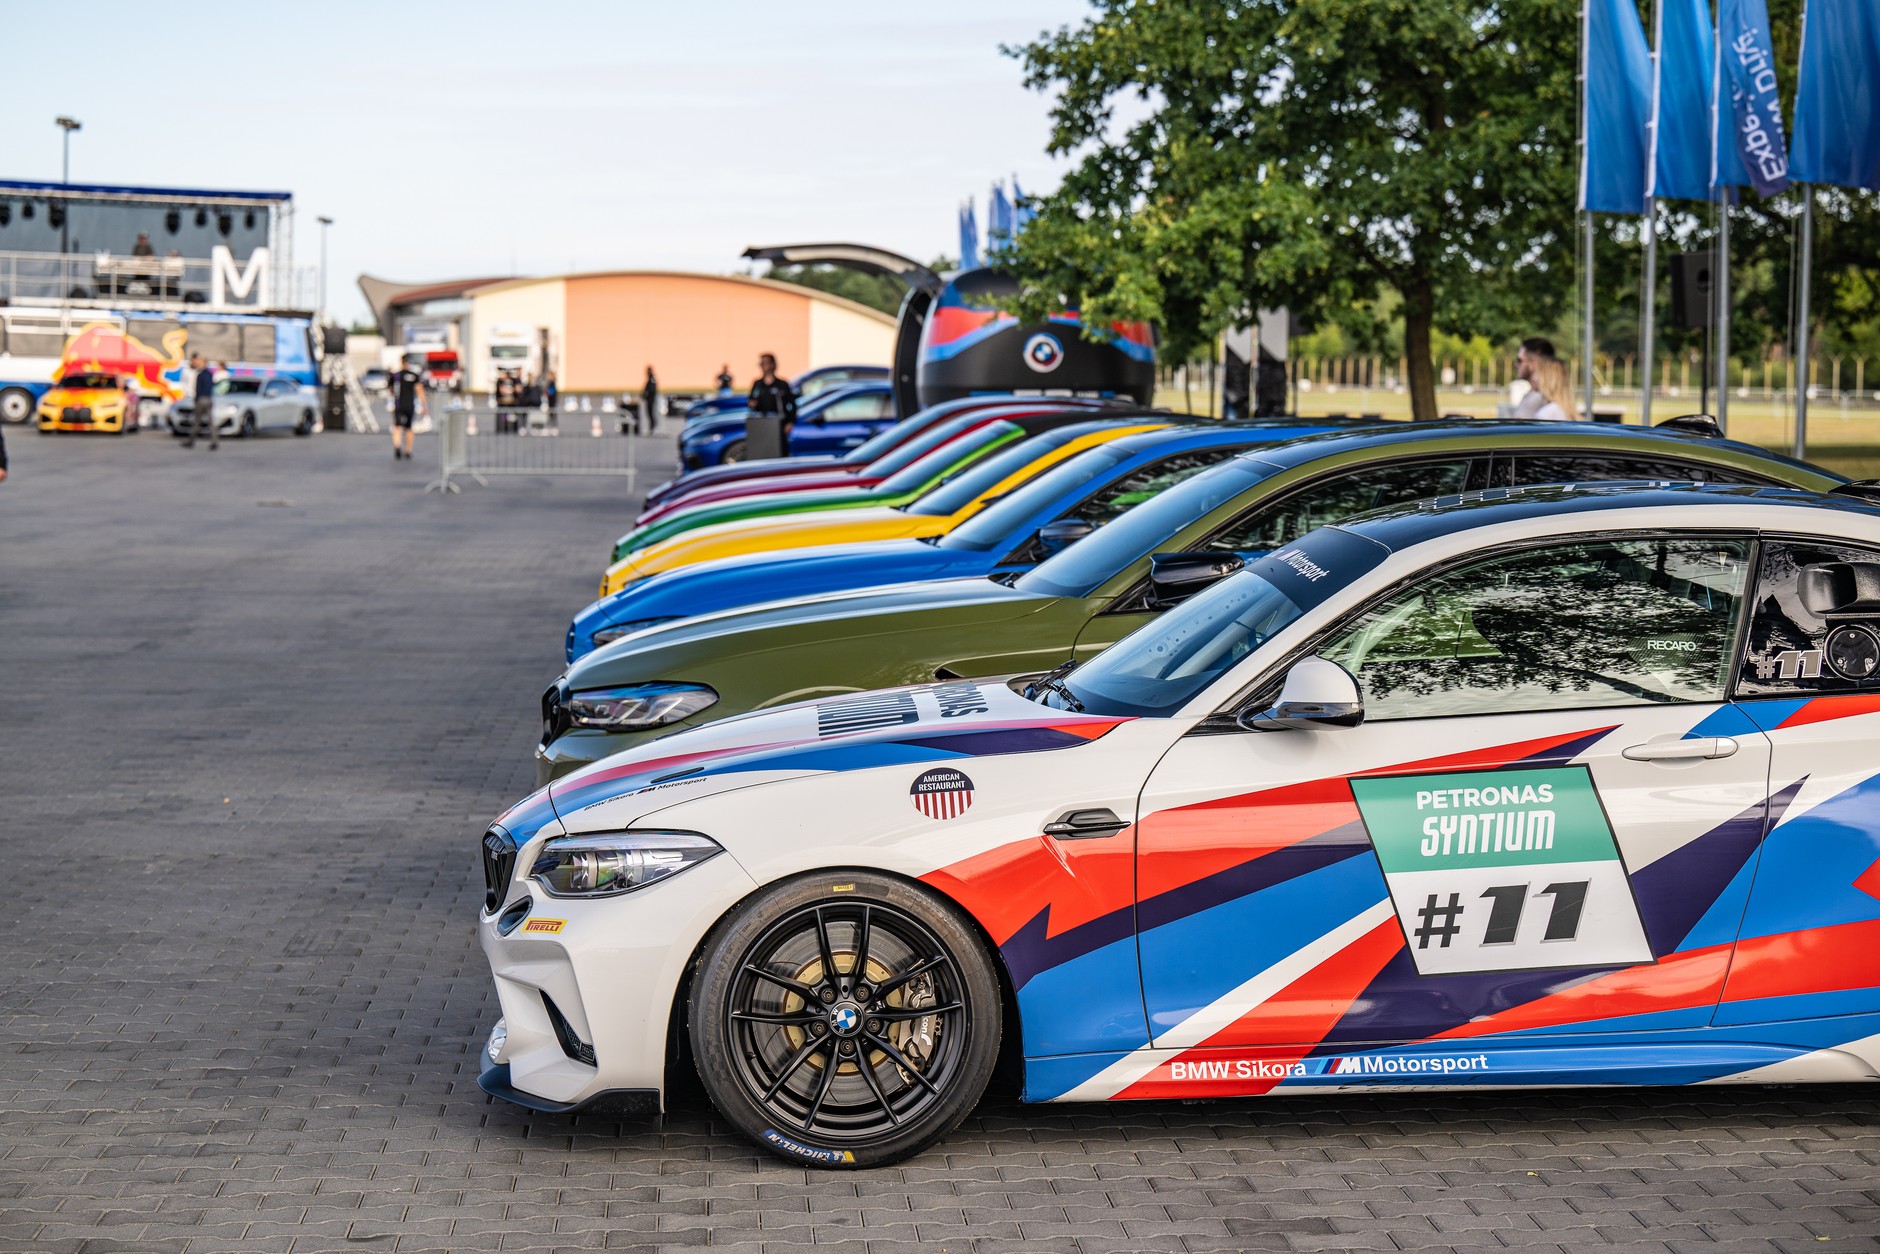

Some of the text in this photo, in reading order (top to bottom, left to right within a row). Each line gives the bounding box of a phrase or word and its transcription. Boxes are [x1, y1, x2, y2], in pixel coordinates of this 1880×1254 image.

[211, 244, 270, 308] M
[1647, 640, 1697, 652] RECARO
[1756, 650, 1823, 679] #11
[657, 777, 707, 790] Motorsport
[918, 781, 966, 792] RESTAURANT
[923, 773, 960, 783] AMERICAN
[1416, 784, 1554, 810] PETRONAS
[1420, 810, 1556, 857] SYNTIUM
[525, 920, 563, 932] PIRELLI
[1414, 877, 1592, 949] #11
[1171, 1061, 1230, 1080] BMW
[1236, 1060, 1307, 1078] Sikora
[1364, 1054, 1489, 1074] Motorsport
[768, 1133, 831, 1161] MICHELIN
